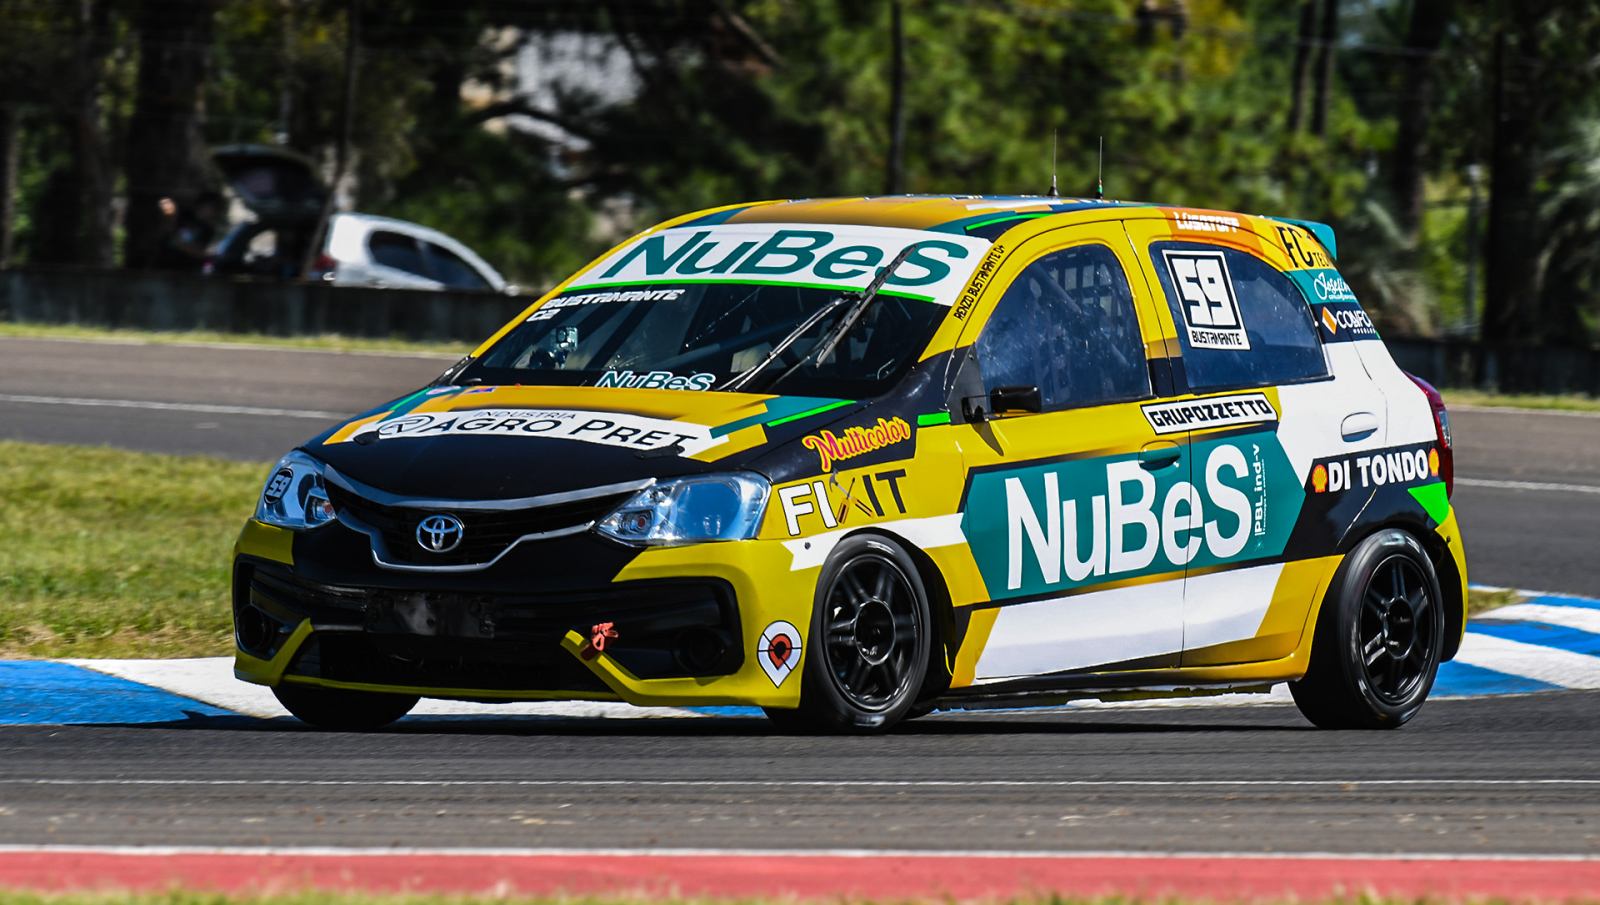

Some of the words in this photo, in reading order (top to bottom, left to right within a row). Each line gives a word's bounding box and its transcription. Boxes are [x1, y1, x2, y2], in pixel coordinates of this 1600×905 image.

[599, 229, 970, 287] NuBeS
[1275, 226, 1315, 268] FC
[539, 288, 686, 310] BUSTAMANTE
[953, 294, 975, 322] RENZO
[966, 251, 1002, 298] BUSTAMANTE
[1170, 257, 1238, 327] 59
[1191, 330, 1243, 346] BUSTAMANTE
[594, 371, 717, 392] NuBeS
[419, 417, 565, 434] AGRO
[567, 419, 698, 449] PRET
[474, 410, 578, 420] INDUSTRIA
[802, 416, 911, 473] Multicolor
[266, 474, 292, 498] 59
[1328, 461, 1351, 493] DI
[1356, 449, 1429, 489] TONDO
[1004, 444, 1252, 591] NuBeS
